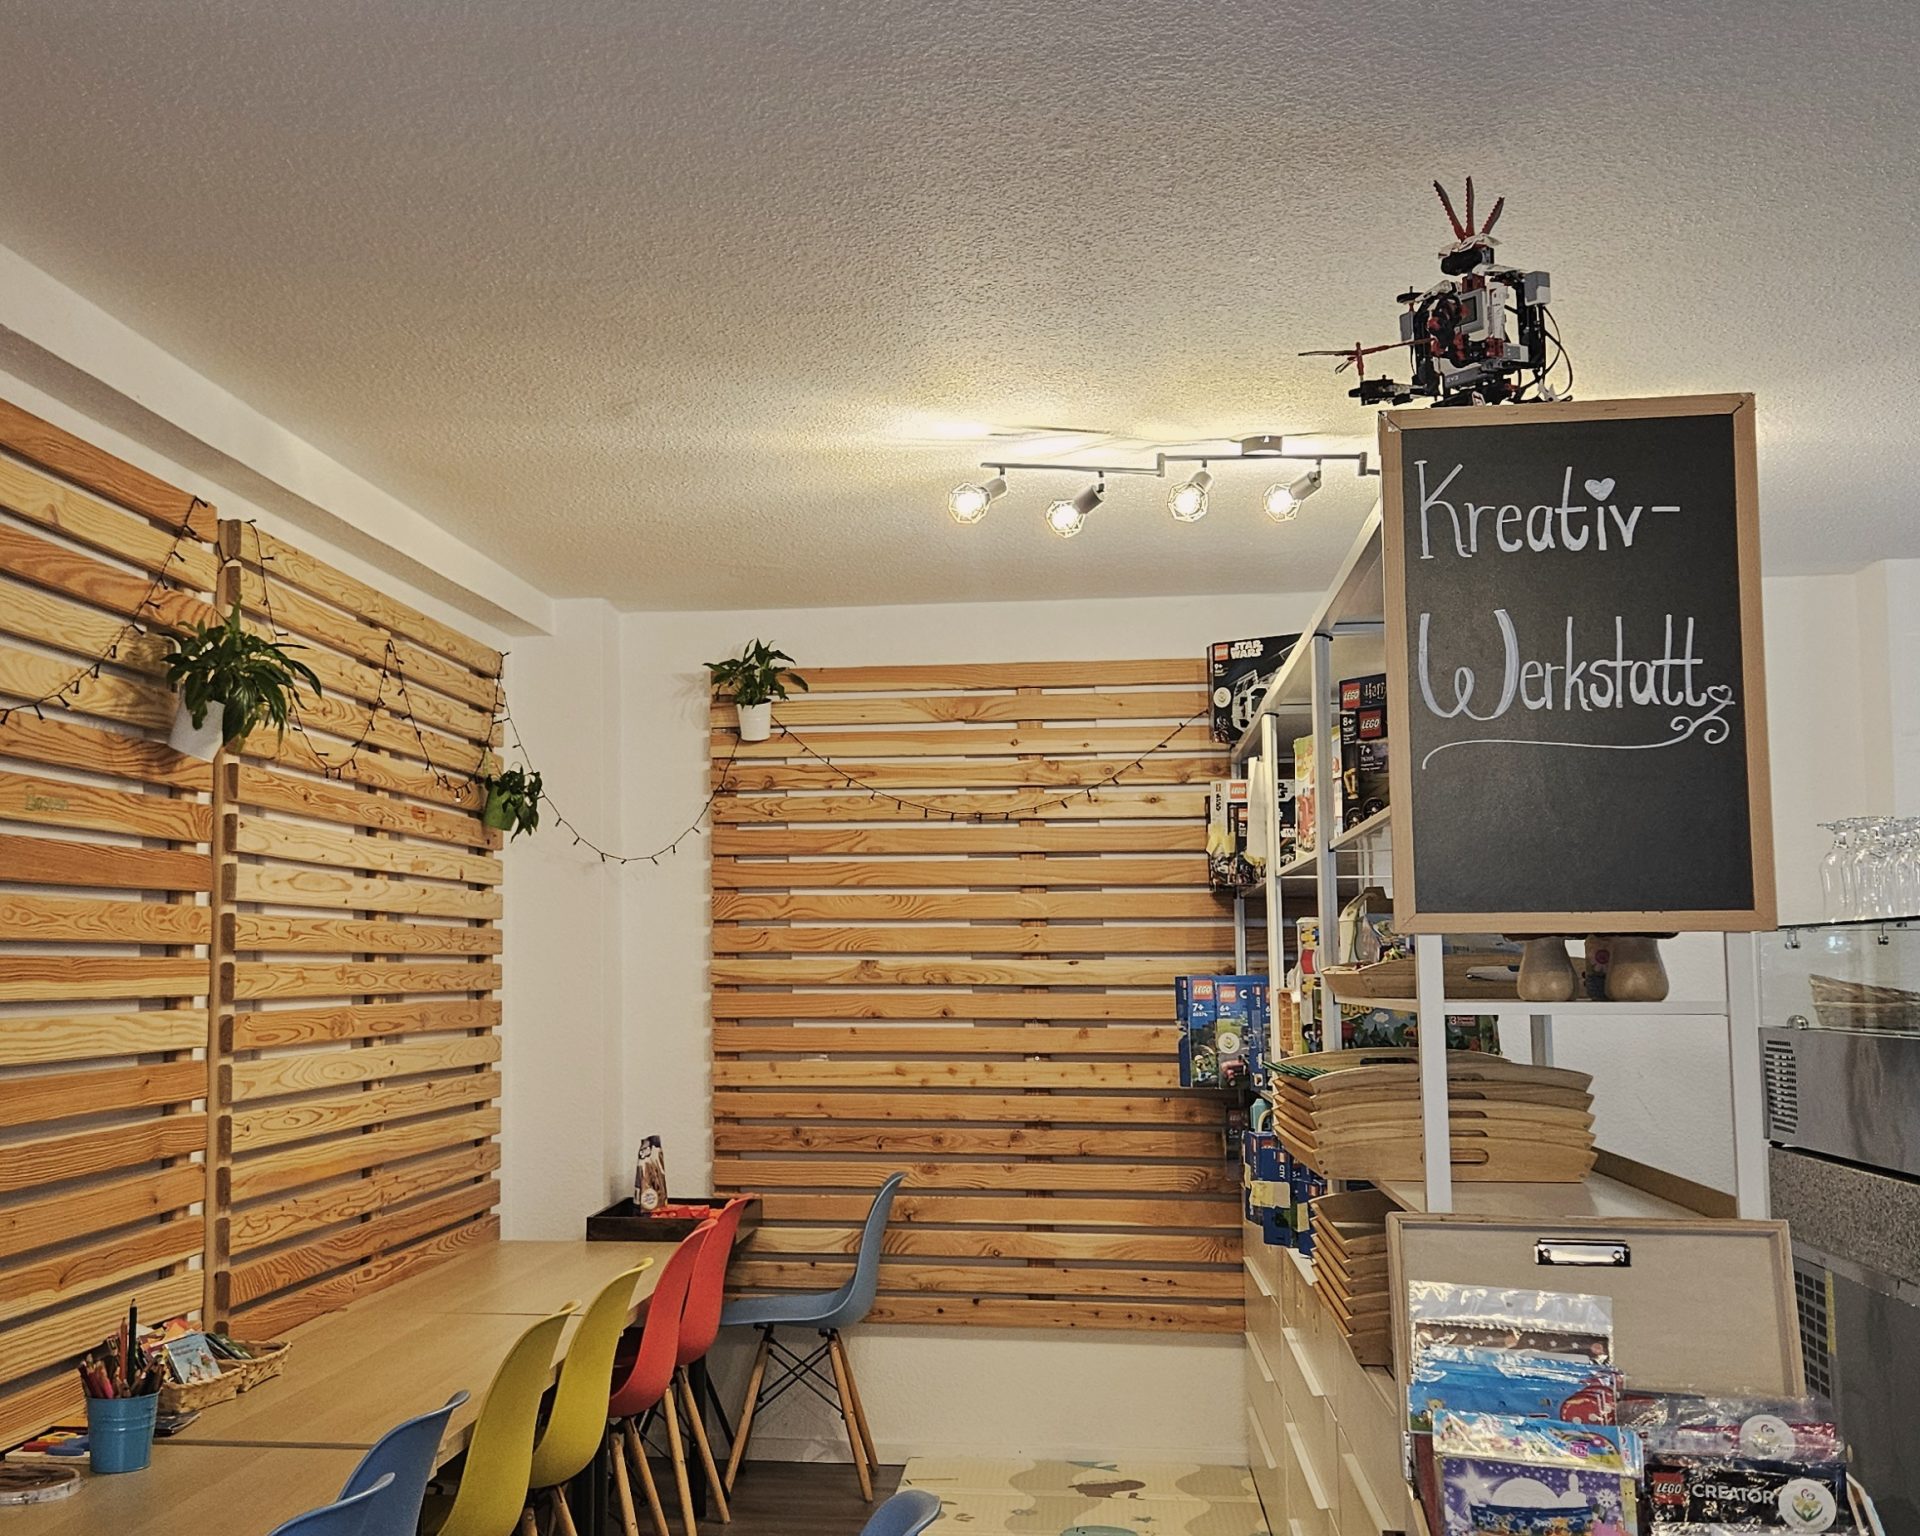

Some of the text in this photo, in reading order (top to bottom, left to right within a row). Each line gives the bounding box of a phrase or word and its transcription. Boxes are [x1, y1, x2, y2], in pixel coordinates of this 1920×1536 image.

[1413, 459, 1681, 559] Kreativ-
[1234, 640, 1264, 651] STAR
[1230, 648, 1262, 659] WARS
[1418, 608, 1707, 721] Werkstatt
[1343, 689, 1359, 701] LEGO
[1361, 718, 1380, 730] LEGO
[1360, 744, 1371, 756] 7+
[1193, 984, 1213, 995] LEGO
[1192, 1003, 1204, 1012] 7+
[1656, 1482, 1775, 1505] LEGO CREATOR
[1654, 1509, 1672, 1521] 6+
